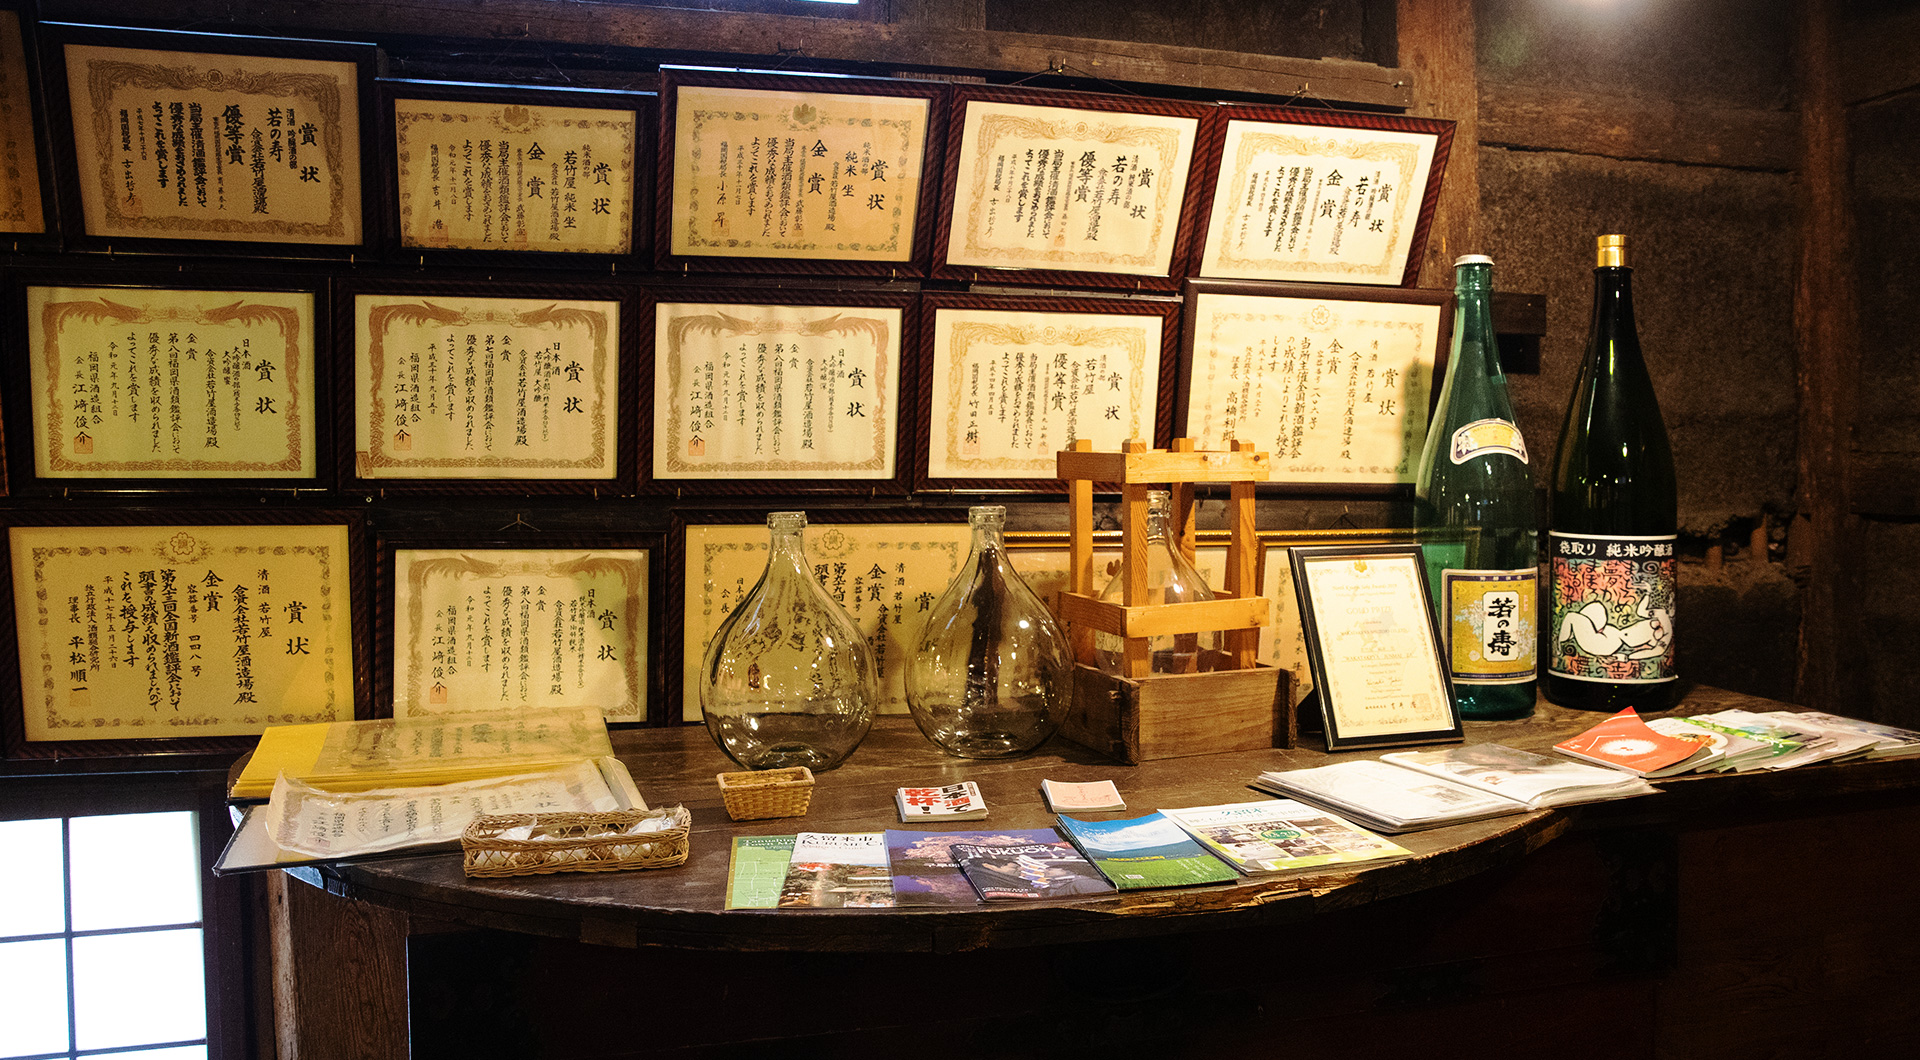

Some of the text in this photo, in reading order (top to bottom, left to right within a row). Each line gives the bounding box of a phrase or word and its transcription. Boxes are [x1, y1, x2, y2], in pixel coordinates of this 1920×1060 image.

[221, 104, 245, 166] 優等賞
[266, 107, 283, 163] 若の寿
[462, 138, 475, 222] よってこれを賞します
[526, 141, 546, 200] 金賞
[563, 150, 578, 190] 若竹屋
[746, 136, 761, 217] よってこれを賞します
[807, 139, 828, 195] 金賞
[844, 150, 859, 178] 純米
[1073, 150, 1098, 203] 優等賞
[1107, 155, 1128, 206] 若の寿
[1320, 168, 1344, 220] 金賞
[1347, 175, 1370, 228] 若の寿
[185, 332, 199, 362] 金賞
[241, 338, 252, 371] 日本酒
[500, 334, 513, 362] 金賞
[551, 341, 562, 377] 日本酒
[788, 343, 800, 370] 金賞
[836, 348, 846, 379] 日本酒
[1267, 335, 1280, 373] します
[1326, 337, 1344, 375] 金賞
[86, 350, 104, 425] 福岡県酒造組合
[126, 331, 141, 424] よってこれを賞します
[148, 332, 162, 453] 優秀な成績を収められました
[254, 359, 278, 415] 賞状
[409, 352, 422, 423] 福岡県酒造組合
[444, 333, 457, 422] よってこれを賞します
[464, 333, 478, 452] 優秀な成績を収められました
[562, 360, 585, 414] 賞状
[703, 360, 715, 429] 福岡県酒造組合
[736, 342, 749, 427] よってこれを賞します
[754, 342, 768, 455] 優秀な成績を収められました
[845, 366, 867, 418] 賞状
[1051, 352, 1068, 412] 優等賞
[1082, 358, 1098, 396] 若竹屋
[1104, 371, 1124, 421] 賞状
[200, 569, 224, 613] 金賞
[257, 568, 273, 639] 清酒 若竹屋
[535, 585, 548, 612] 金賞
[586, 588, 597, 619] 日本酒
[866, 562, 887, 602] 金賞
[891, 562, 906, 625] 清酒 若竹屋
[68, 595, 89, 692] 理事長 平松順一
[102, 575, 118, 669] 平成十七年五月二十六日
[119, 570, 140, 668] これを授与します
[282, 600, 311, 656] 賞状
[445, 604, 458, 675] 福岡県酒造組合
[480, 585, 494, 673] よってこれを賞します
[499, 585, 513, 702] 優秀な成績を収められました
[596, 608, 618, 662] 賞状
